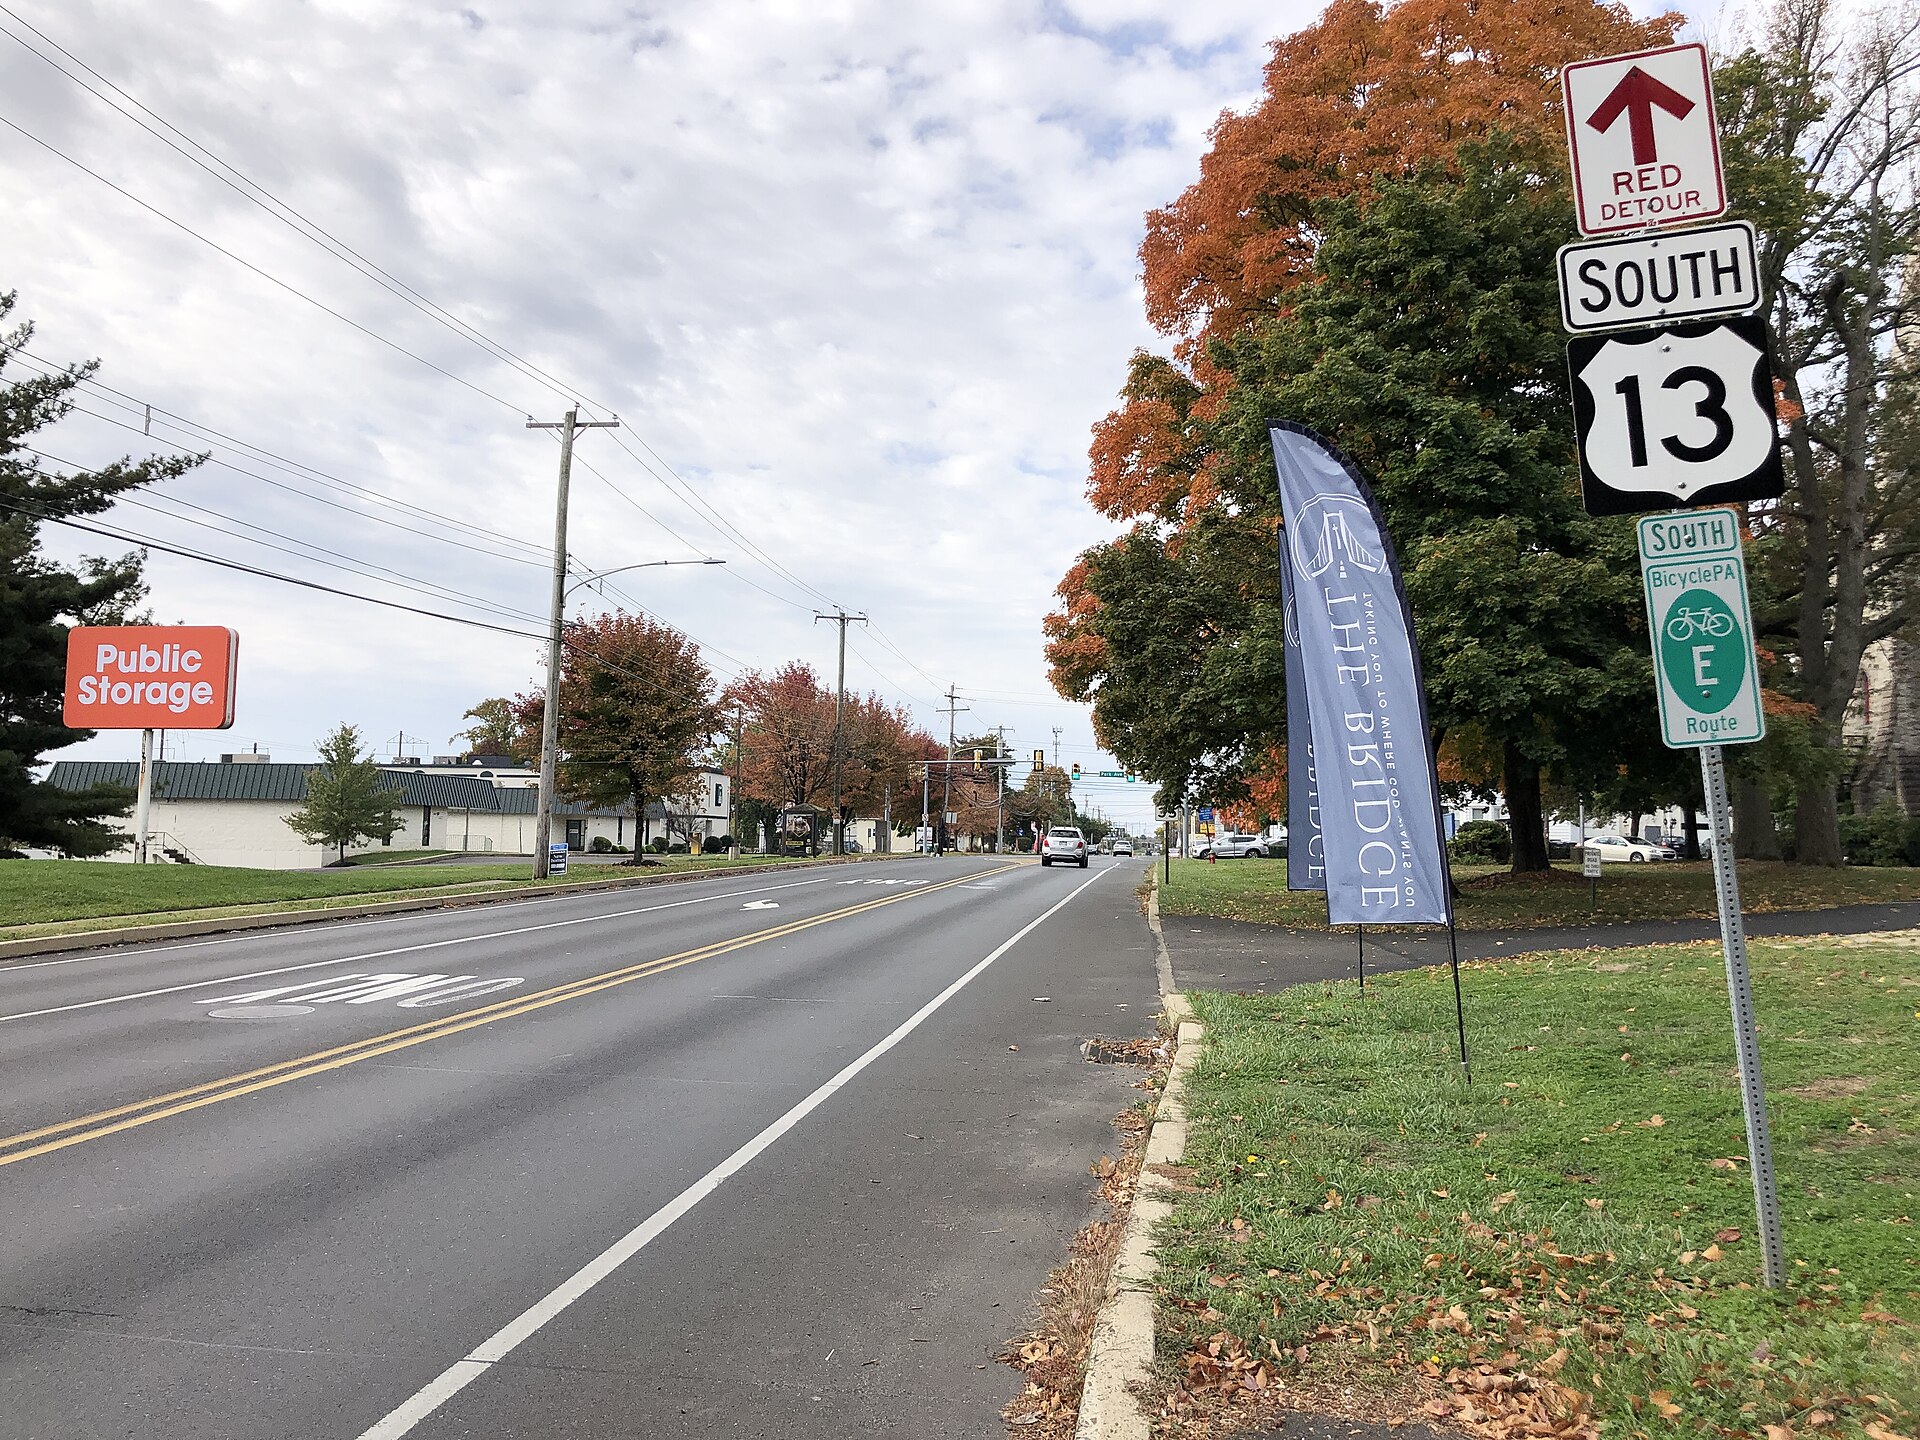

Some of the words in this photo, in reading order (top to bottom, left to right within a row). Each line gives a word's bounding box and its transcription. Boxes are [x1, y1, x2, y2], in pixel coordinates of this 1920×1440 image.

[1612, 164, 1682, 196] RED
[1600, 190, 1701, 221] DETOUR
[1578, 246, 1742, 313] SOUTH
[1614, 365, 1735, 468] 13
[1651, 520, 1726, 552] SOUTH
[96, 644, 202, 673] Public
[1691, 644, 1720, 687] E
[77, 676, 214, 713] Storage
[1686, 715, 1738, 735] Route
[192, 973, 526, 1008] ONLY
